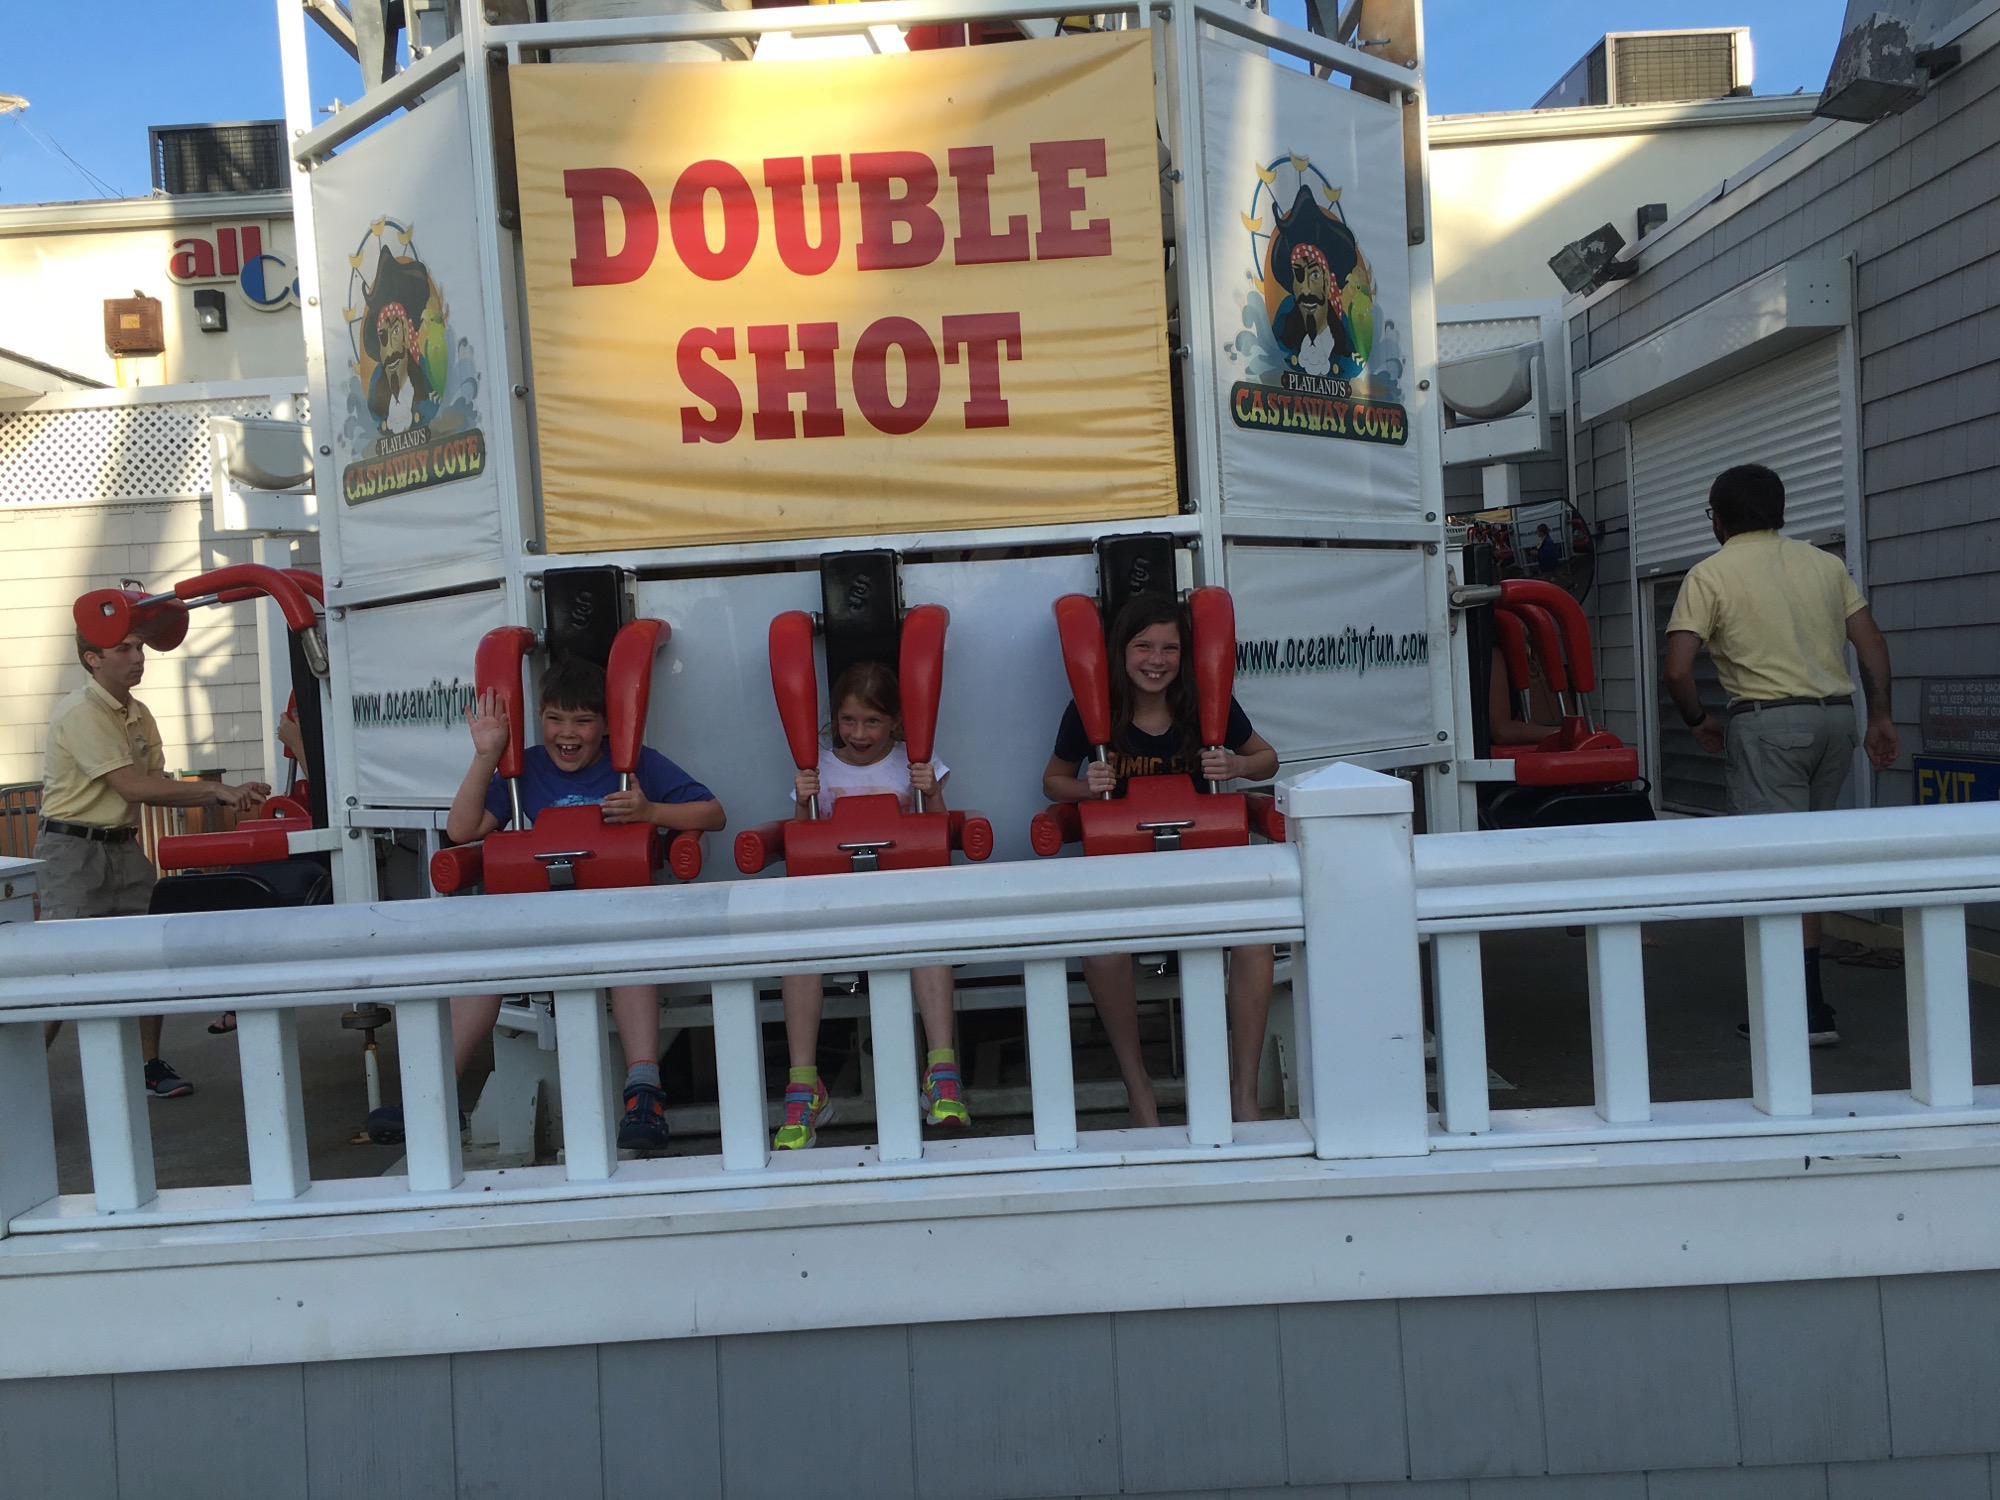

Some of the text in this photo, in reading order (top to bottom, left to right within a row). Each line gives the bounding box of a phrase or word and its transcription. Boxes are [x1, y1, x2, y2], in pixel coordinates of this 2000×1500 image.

[563, 138, 1112, 287] DOUBLE
[170, 226, 262, 279] all
[676, 311, 1023, 444] SHOT
[1288, 373, 1346, 398] PLAYLAND'S
[1235, 388, 1404, 441] CASTAWAY COVE
[381, 428, 427, 455] PLAYLAND'S
[345, 434, 481, 501] CASTAWAY COVE
[1235, 625, 1429, 671] www.oceancityfun.com
[1940, 694, 1948, 704] TO
[1949, 695, 1965, 705] KEEP
[1966, 695, 1983, 705] YOUR
[1947, 683, 1964, 693] YOUR
[1965, 683, 1983, 693] HEAD
[1942, 706, 1957, 716] FEET
[1959, 706, 1989, 717] STRAIGHT
[1950, 740, 1970, 751] THESE
[1974, 730, 1998, 741] PLEASE
[1918, 768, 1976, 805] EXIT
